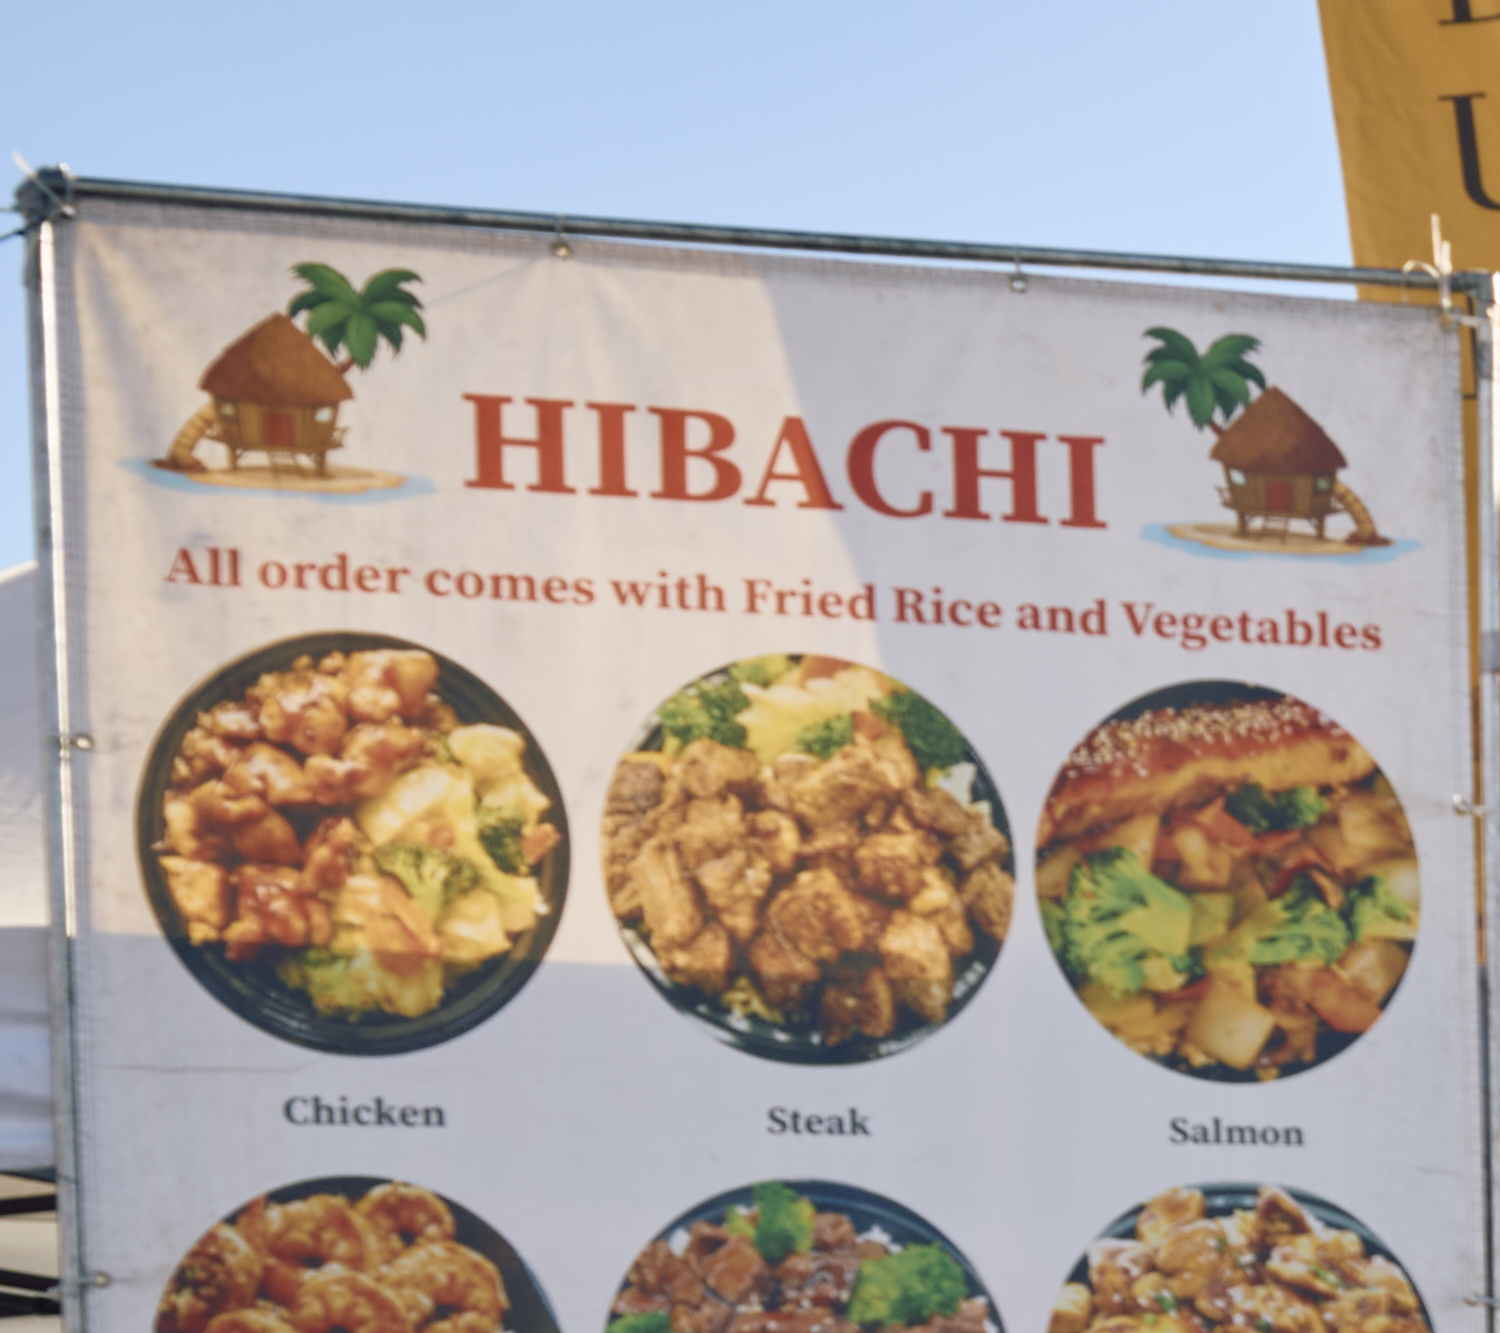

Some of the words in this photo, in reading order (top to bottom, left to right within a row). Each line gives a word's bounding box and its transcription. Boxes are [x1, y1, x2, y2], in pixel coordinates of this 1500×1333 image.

[461, 392, 1109, 531] HIBACHI
[164, 546, 242, 588] All
[257, 552, 412, 595] order
[423, 568, 595, 605] comes
[610, 570, 727, 613] with
[744, 578, 880, 623] Fried
[893, 586, 1002, 629] Rice
[1016, 598, 1109, 637] and
[1121, 601, 1383, 651] Vegetables
[282, 1094, 447, 1128] Chicken
[767, 1106, 871, 1137] Steak
[1168, 1116, 1305, 1148] Salmon
